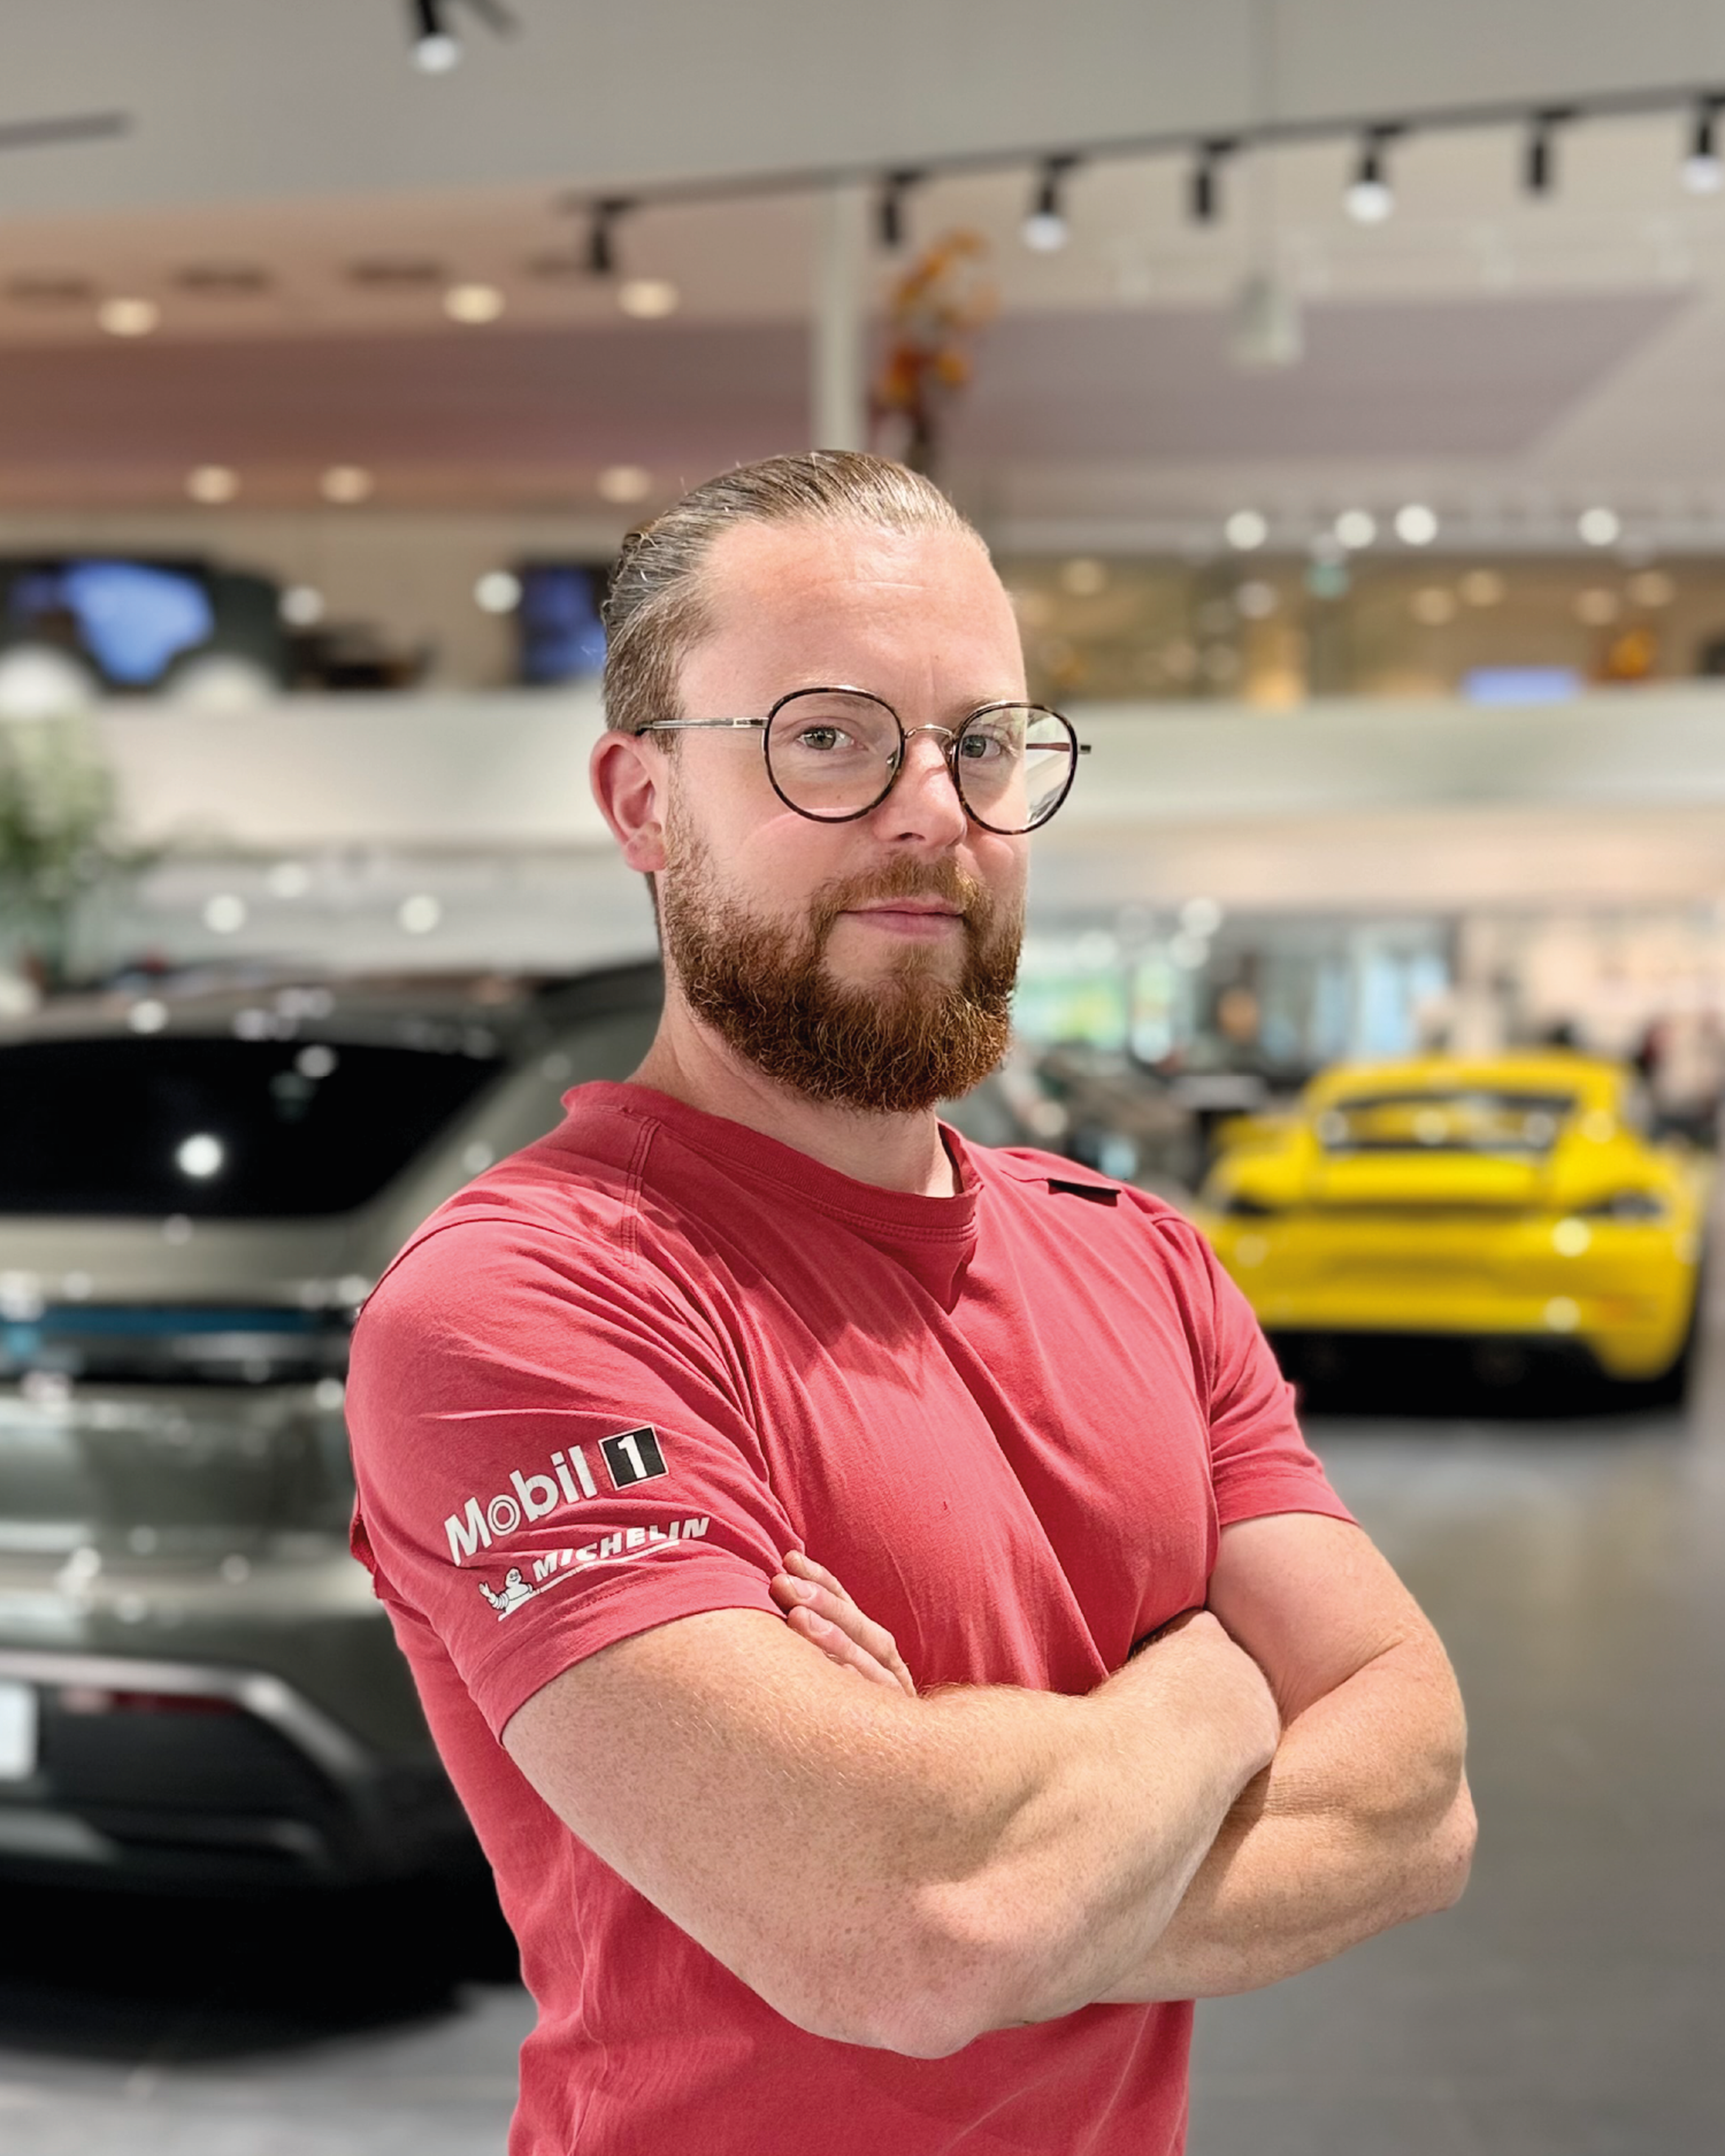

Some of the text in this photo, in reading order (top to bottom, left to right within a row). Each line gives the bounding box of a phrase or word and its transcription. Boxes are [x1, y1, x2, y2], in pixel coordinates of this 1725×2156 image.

[444, 1435, 647, 1566] Mobil 1
[532, 1517, 710, 1582] MICHELIN
